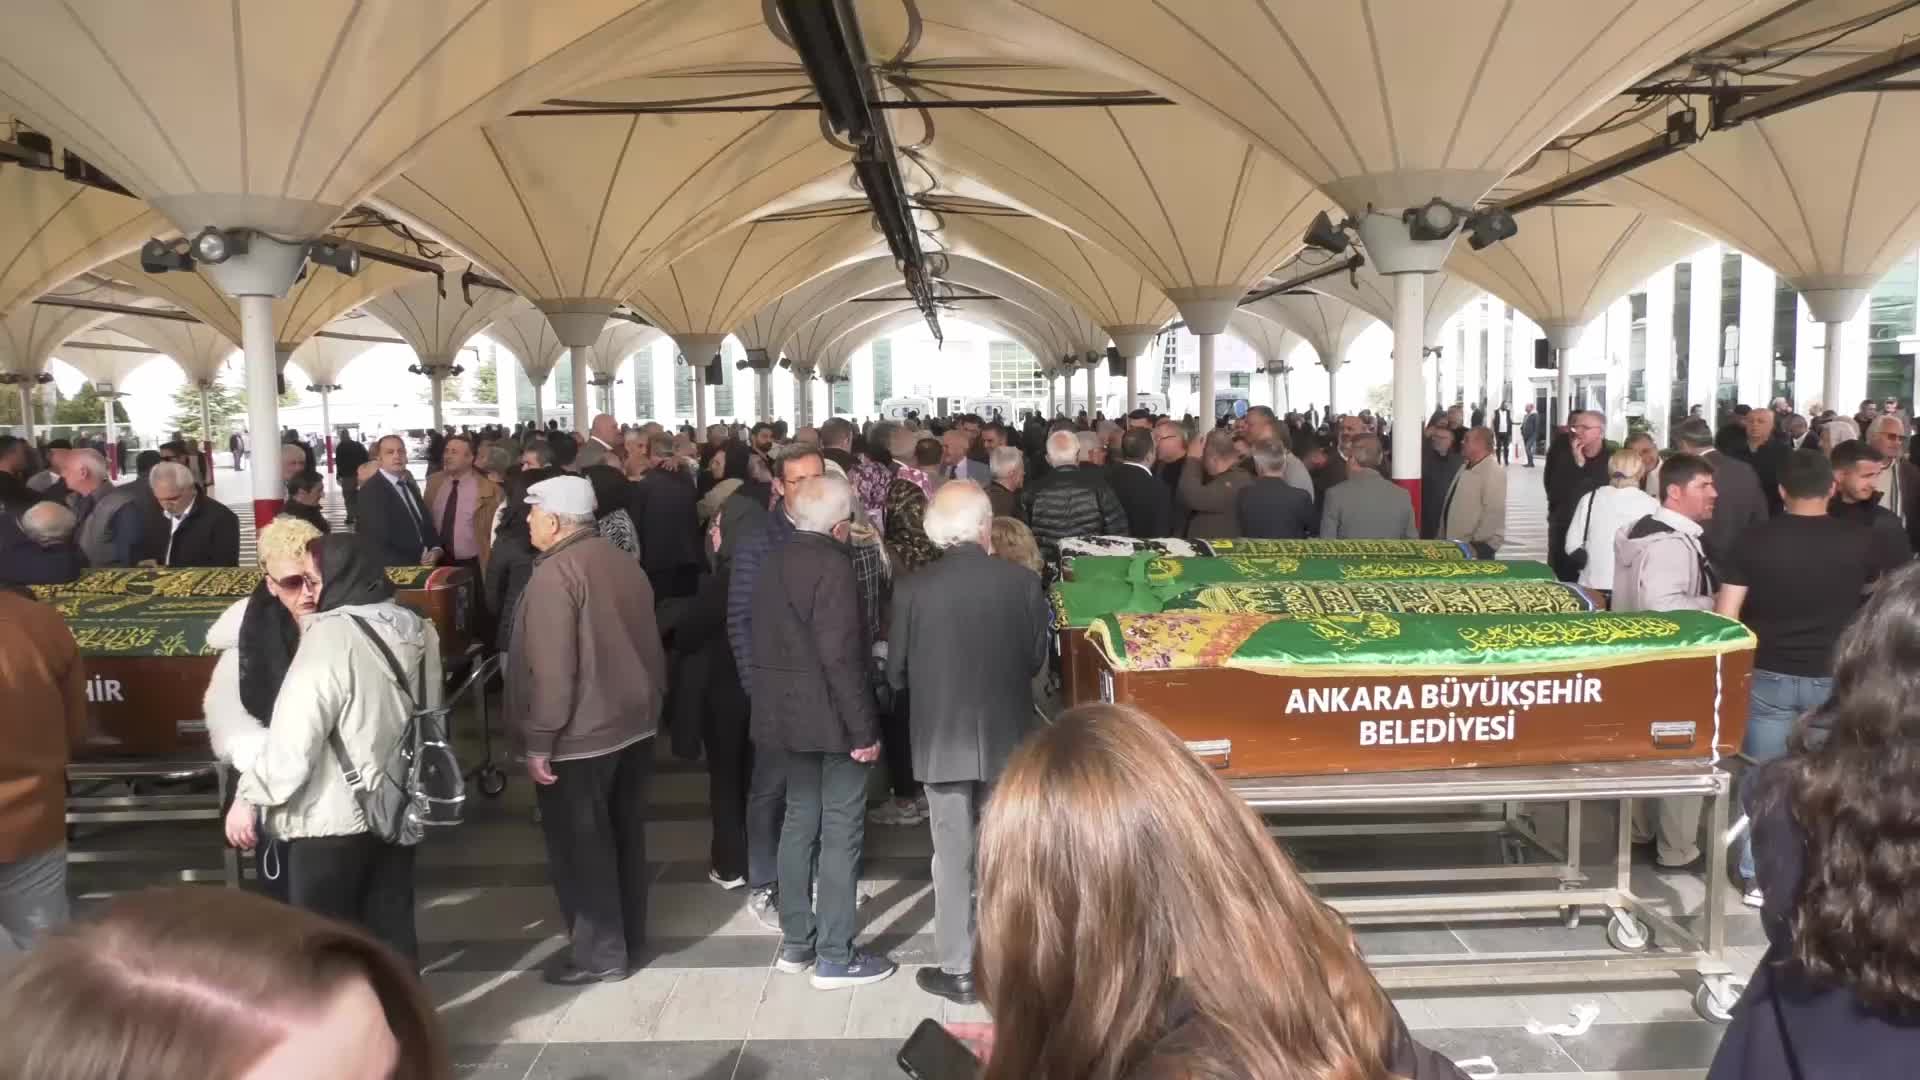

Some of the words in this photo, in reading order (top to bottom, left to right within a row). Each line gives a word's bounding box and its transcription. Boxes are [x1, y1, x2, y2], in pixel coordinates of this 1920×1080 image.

[1284, 684, 1414, 714] ANKARA
[1421, 672, 1602, 711] BÜYÜKŞEHİR
[1359, 709, 1516, 746] BELEDİYESİ
